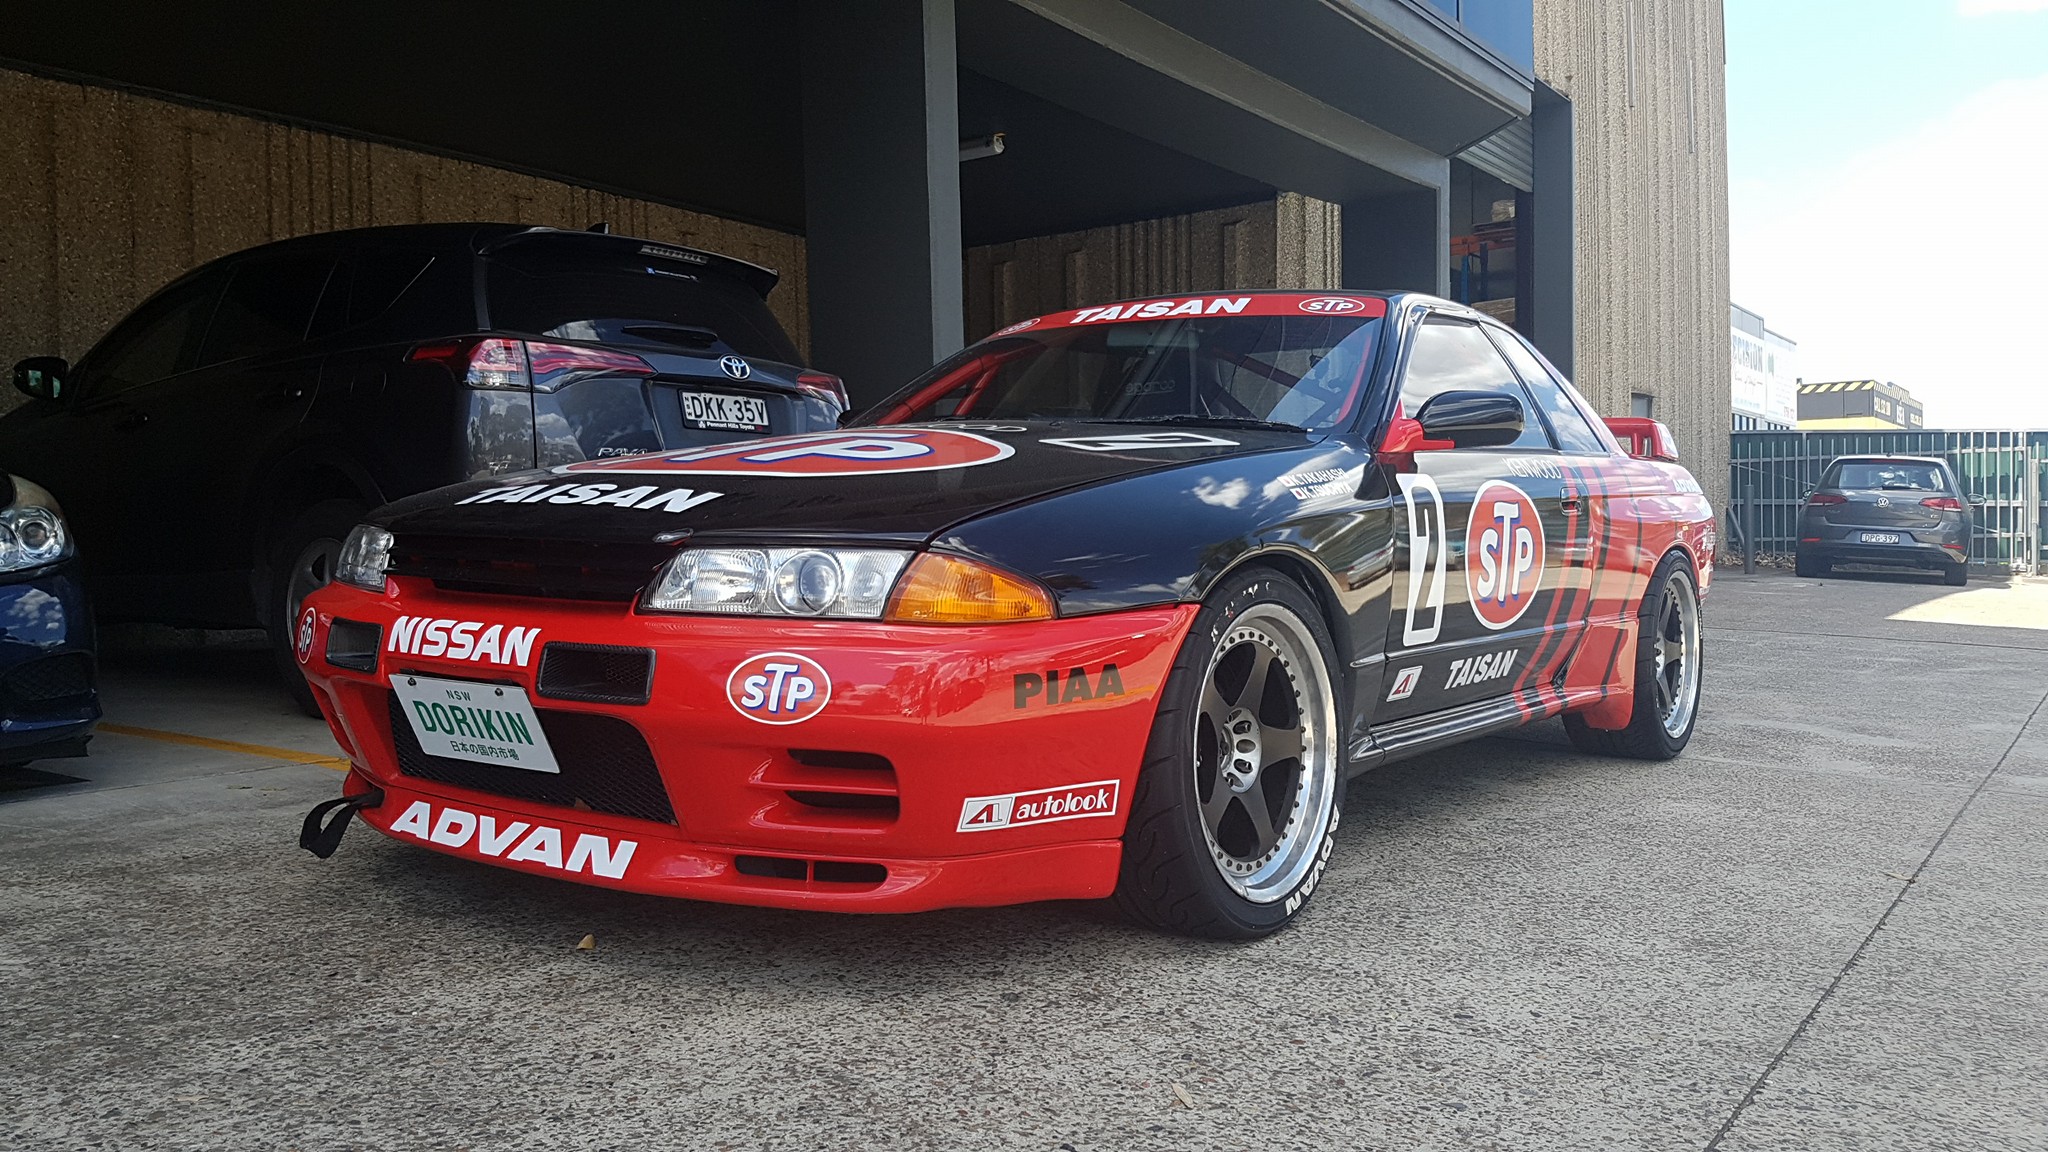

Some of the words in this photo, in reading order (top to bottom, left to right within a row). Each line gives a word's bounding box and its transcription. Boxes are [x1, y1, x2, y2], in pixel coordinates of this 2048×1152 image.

[1070, 297, 1252, 324] TAISAN
[1309, 299, 1354, 313] STP
[454, 483, 725, 513] TAISAN
[1476, 502, 1534, 603] STP
[299, 615, 313, 653] STP
[388, 616, 541, 667] NISSAN
[741, 663, 815, 713] STP
[1013, 664, 1126, 709] PIAA
[1444, 649, 1518, 690] TAISAN
[446, 689, 471, 701] NSW
[413, 700, 534, 745] DORIKIN
[450, 741, 520, 760] 日本の国内市場
[1016, 788, 1109, 821] autolook
[390, 800, 638, 879] ADVAN
[1285, 803, 1340, 917] ADVAN
